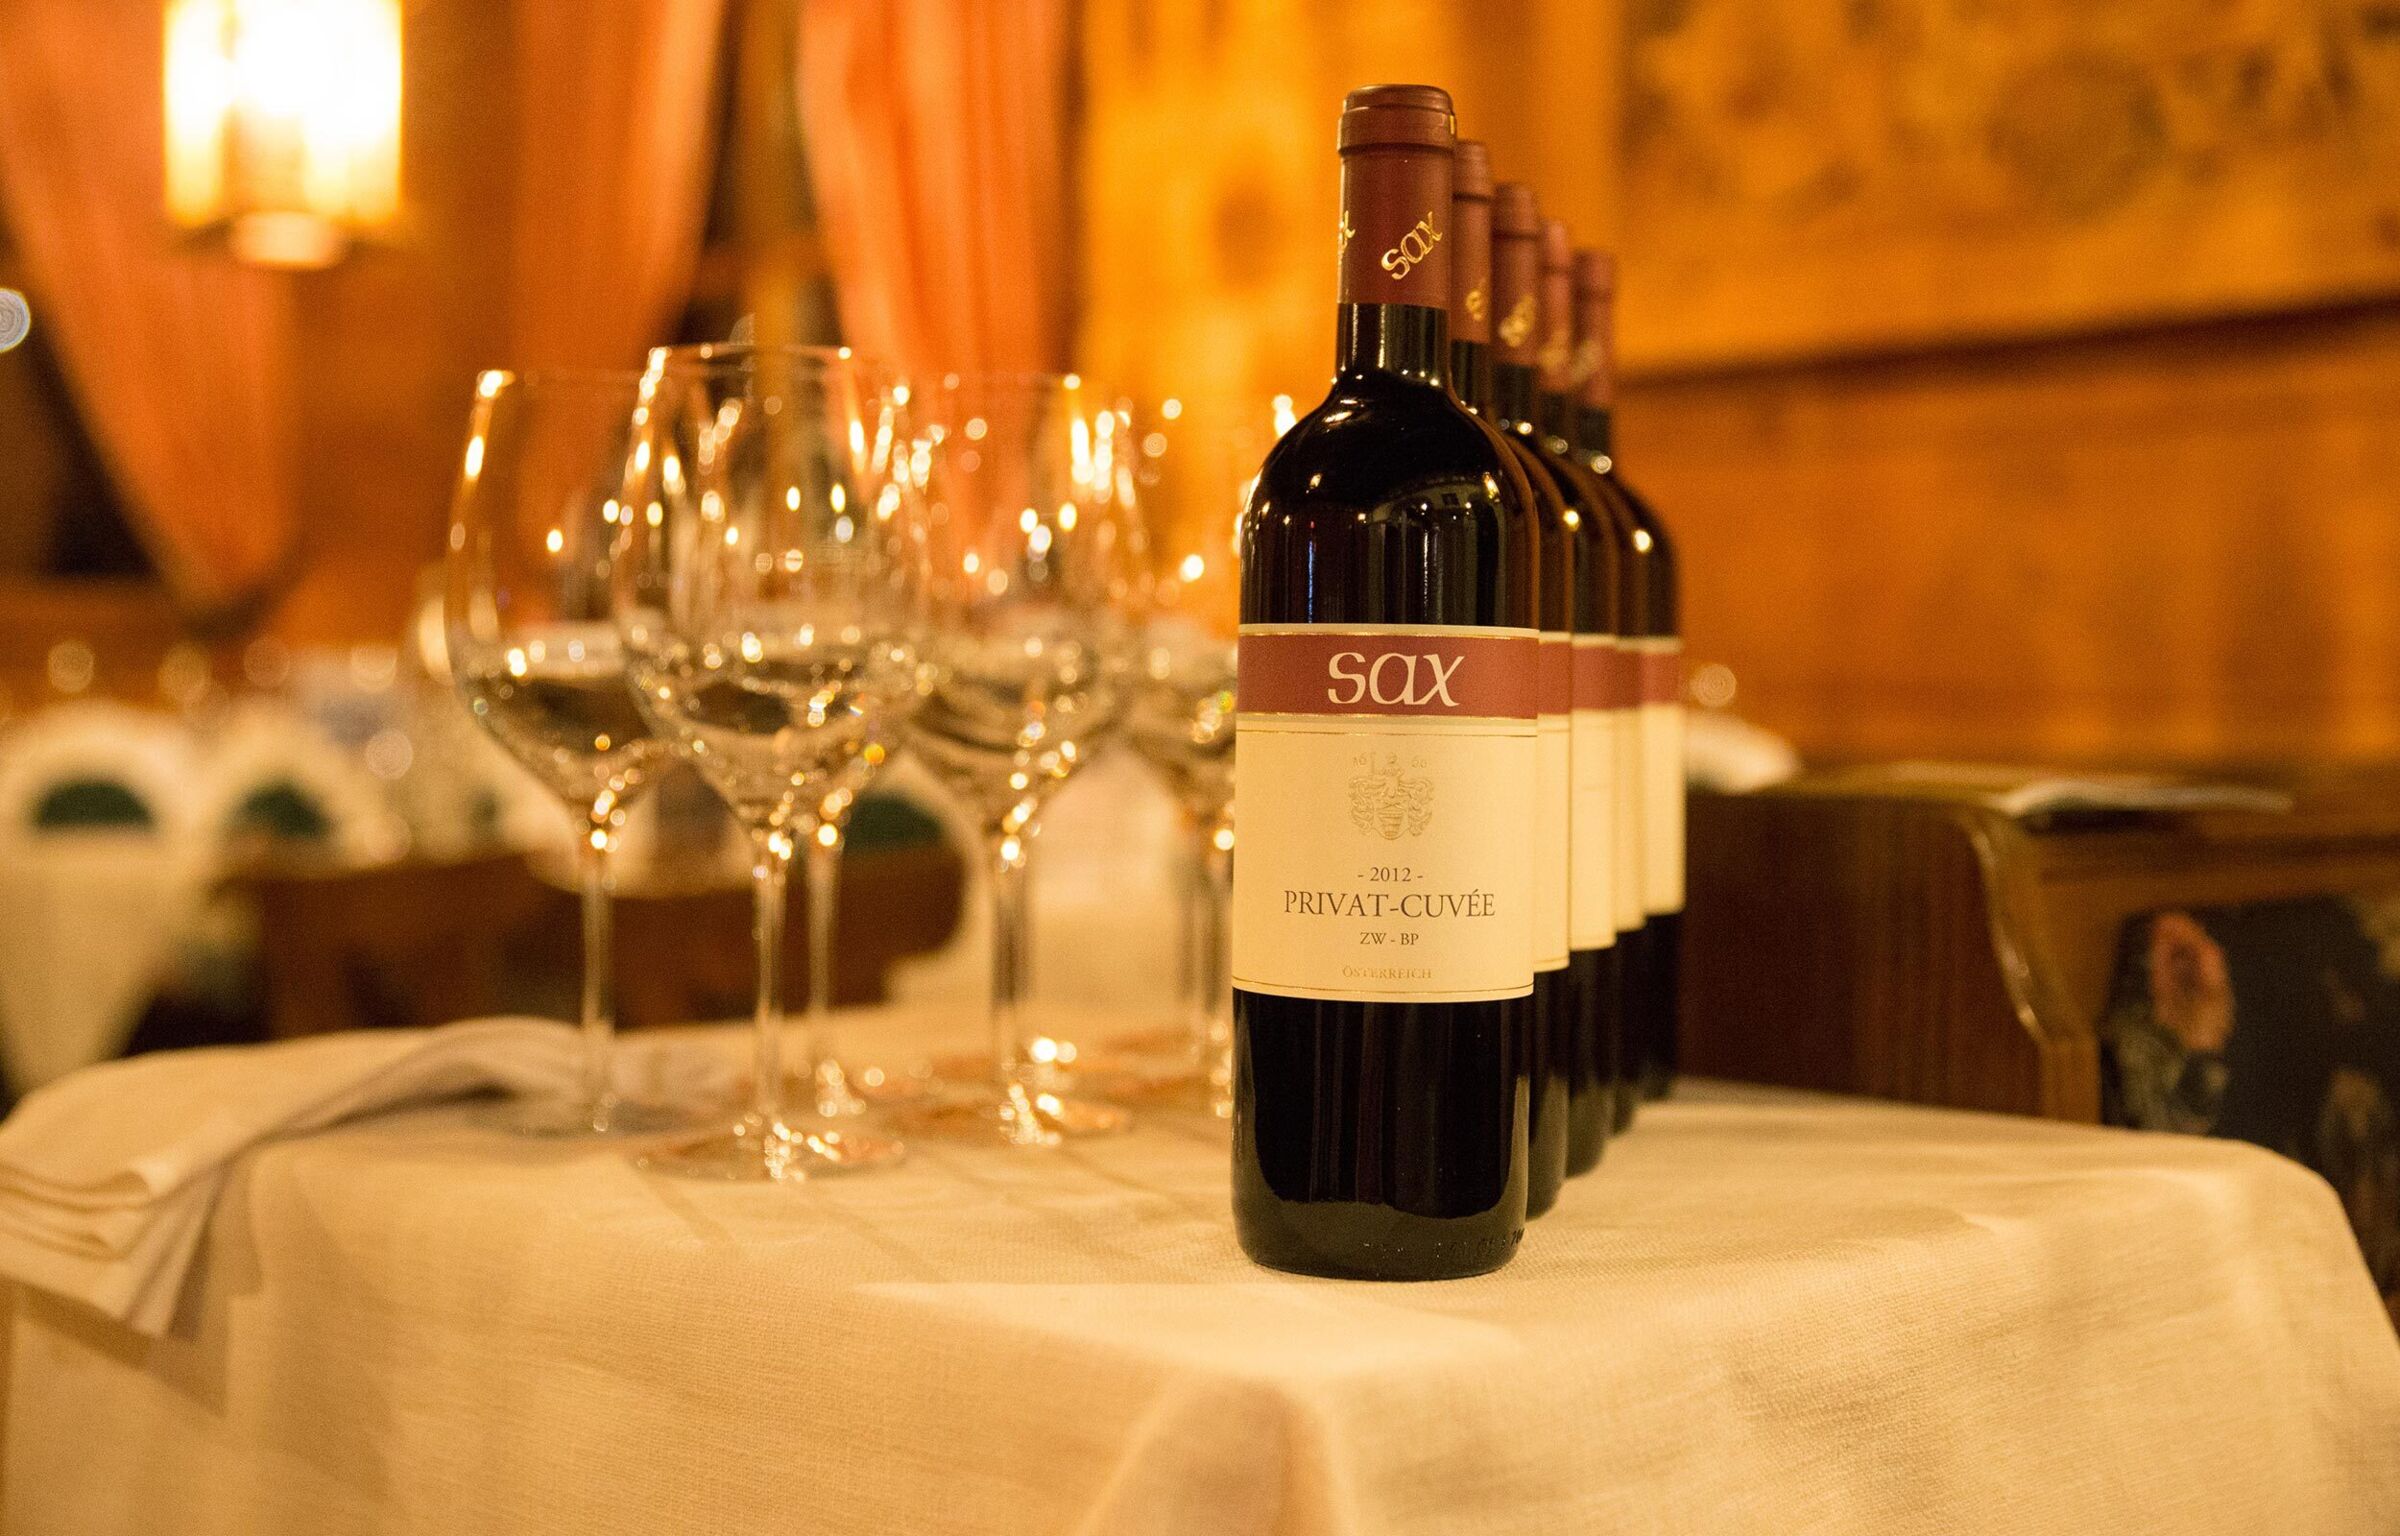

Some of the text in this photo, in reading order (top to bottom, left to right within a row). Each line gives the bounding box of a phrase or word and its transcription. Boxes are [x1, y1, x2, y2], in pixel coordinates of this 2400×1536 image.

[1380, 210, 1443, 281] sax
[1326, 651, 1465, 707] sax
[1369, 866, 1412, 883] 2012
[1283, 887, 1496, 919] PRIVAT-CUVÉE
[1359, 931, 1387, 946] ZW
[1400, 932, 1420, 946] BP
[1341, 964, 1433, 981] ÖSTERREICH
